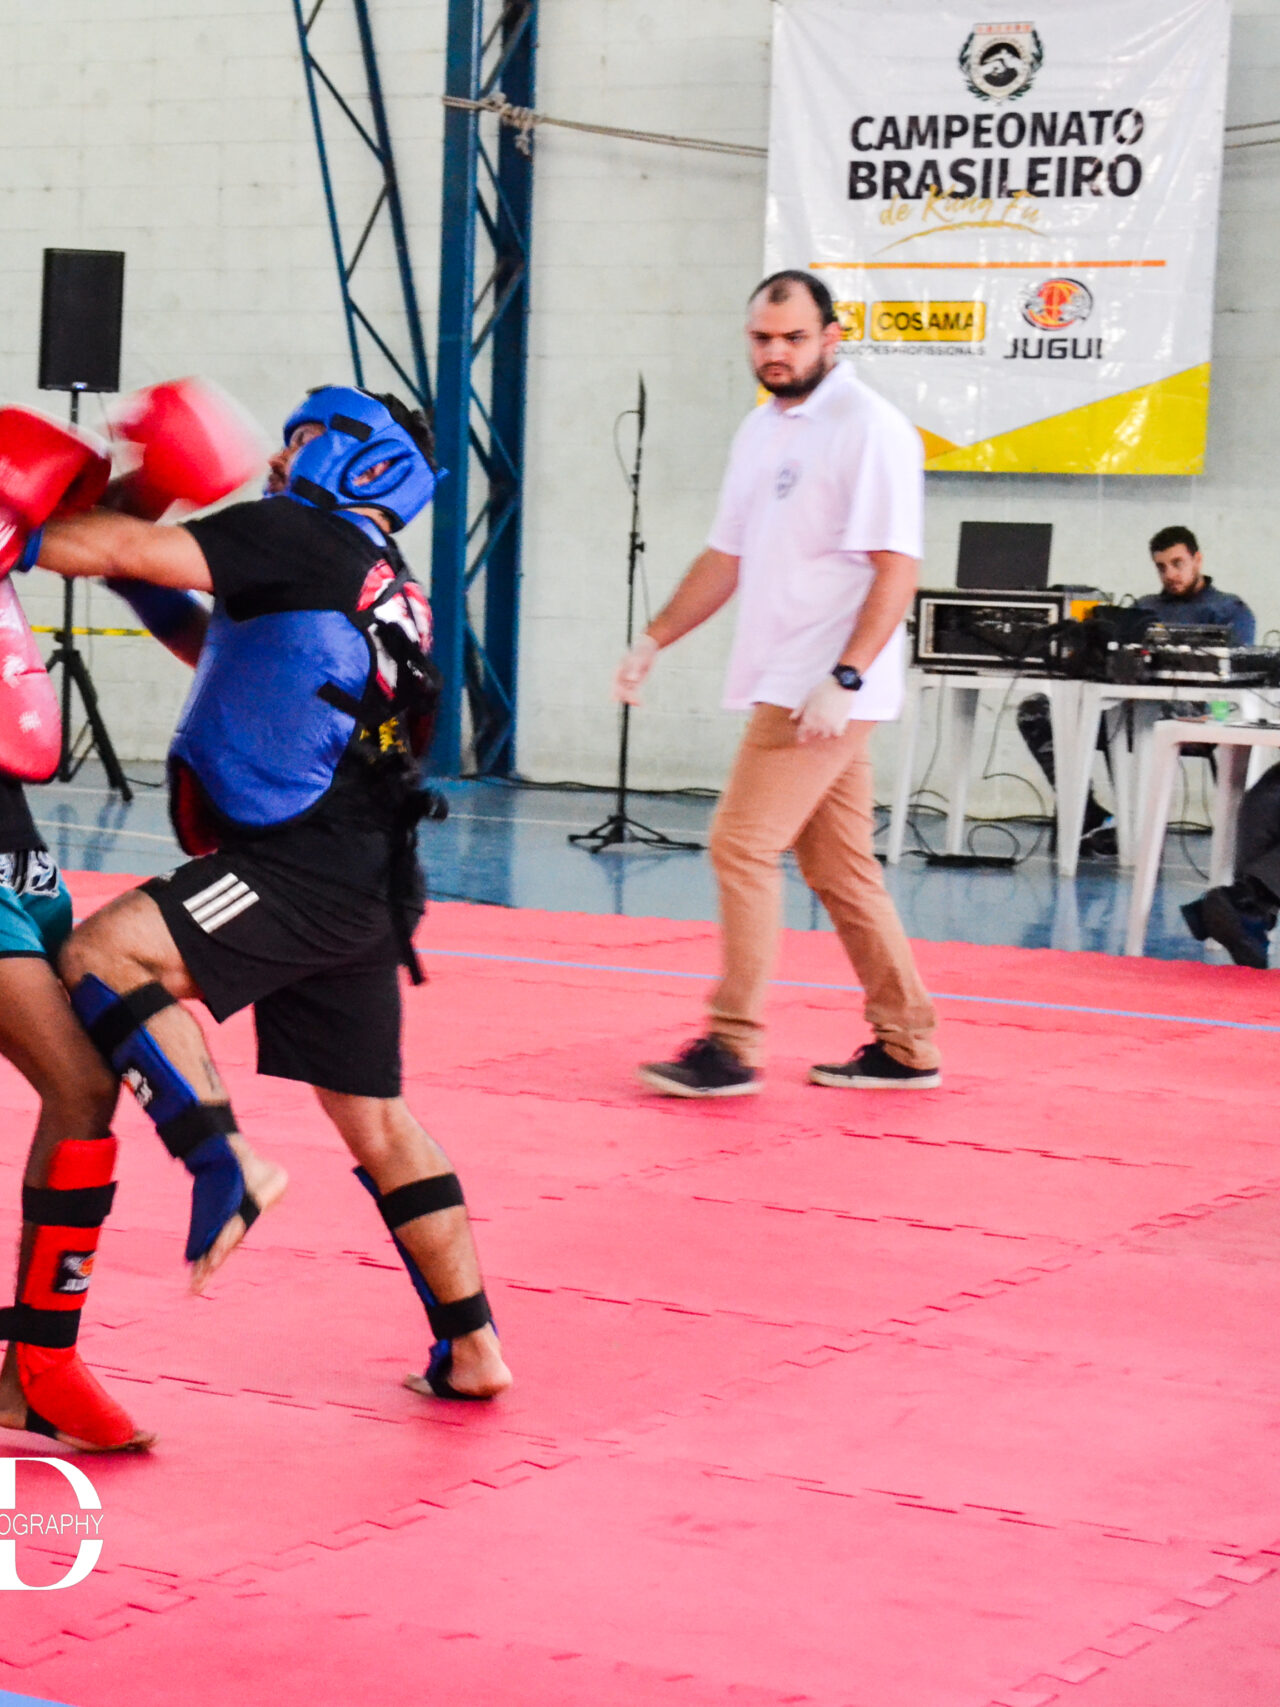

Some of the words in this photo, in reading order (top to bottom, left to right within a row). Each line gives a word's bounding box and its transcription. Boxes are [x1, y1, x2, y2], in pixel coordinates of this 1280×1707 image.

[850, 108, 1144, 151] CAMPEONATO
[848, 154, 1142, 200] BRASILEIRO
[879, 194, 911, 225] de
[922, 184, 994, 222] Kung
[1002, 190, 1040, 222] Fu
[877, 312, 976, 331] COSAMA
